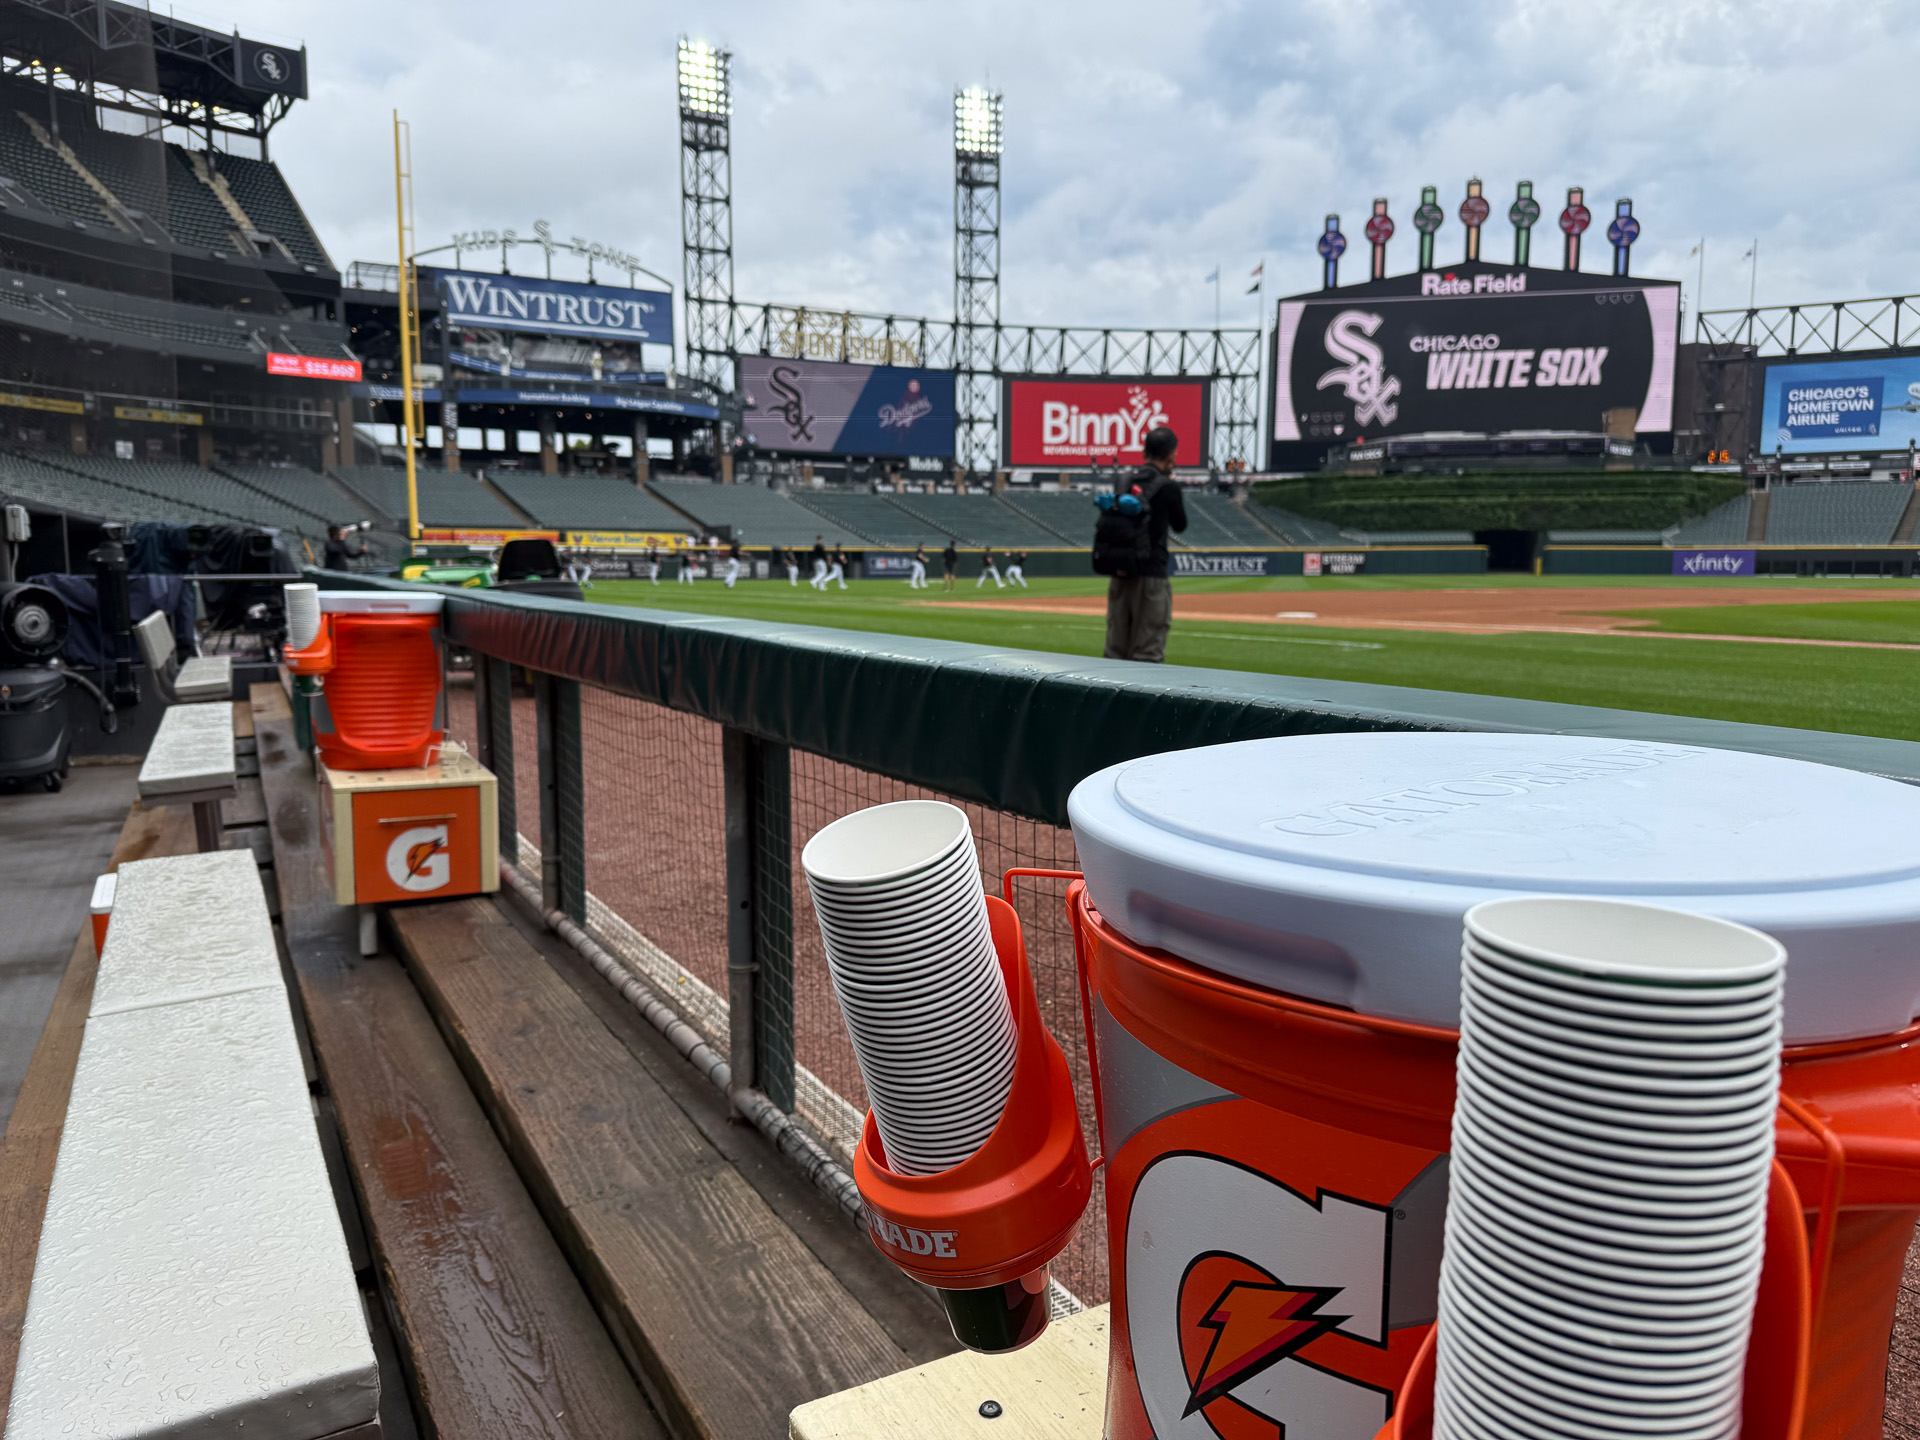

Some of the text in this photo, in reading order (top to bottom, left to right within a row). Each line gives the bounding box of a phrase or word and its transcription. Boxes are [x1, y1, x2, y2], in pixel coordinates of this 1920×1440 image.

[453, 229, 518, 252] KIDS
[571, 236, 641, 272] ZONE
[1421, 272, 1527, 296] Rate Field
[1409, 333, 1500, 353] CHICAGO
[1426, 346, 1609, 390] WHITE SOX
[1788, 386, 1869, 402] CHICAGO'S
[1787, 398, 1874, 414] HOMETOWN
[1786, 412, 1840, 427] AIRLINE
[1683, 552, 1744, 574] xfinity
[1259, 743, 1706, 838] GATORADE
